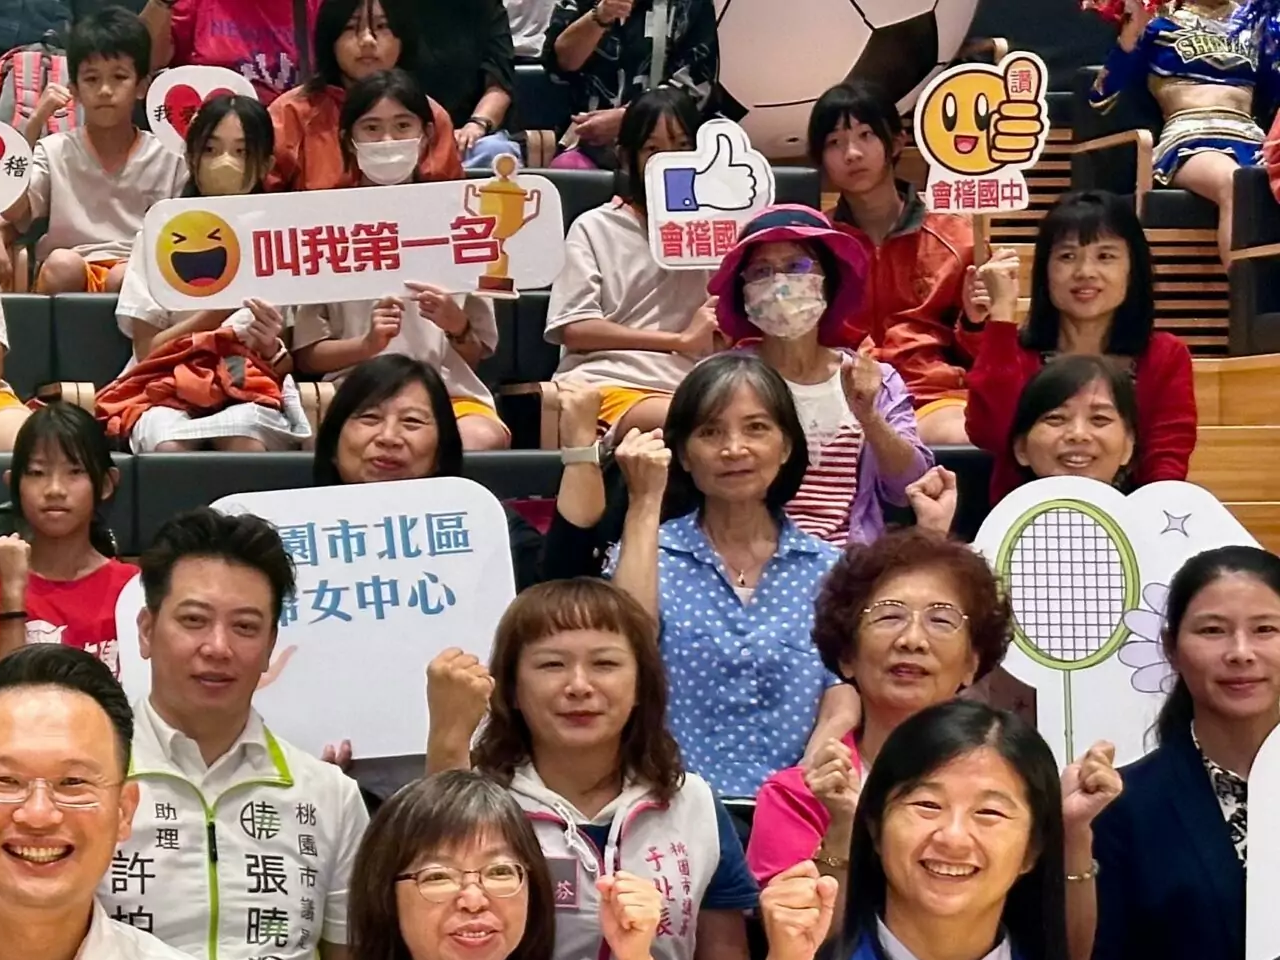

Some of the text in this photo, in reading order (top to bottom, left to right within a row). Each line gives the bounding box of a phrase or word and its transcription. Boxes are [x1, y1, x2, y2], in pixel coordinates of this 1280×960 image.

[931, 177, 1023, 210] 會稽國中
[252, 215, 500, 277] 叫我第一名
[660, 220, 742, 258] 會稽國
[154, 802, 181, 850] 助理
